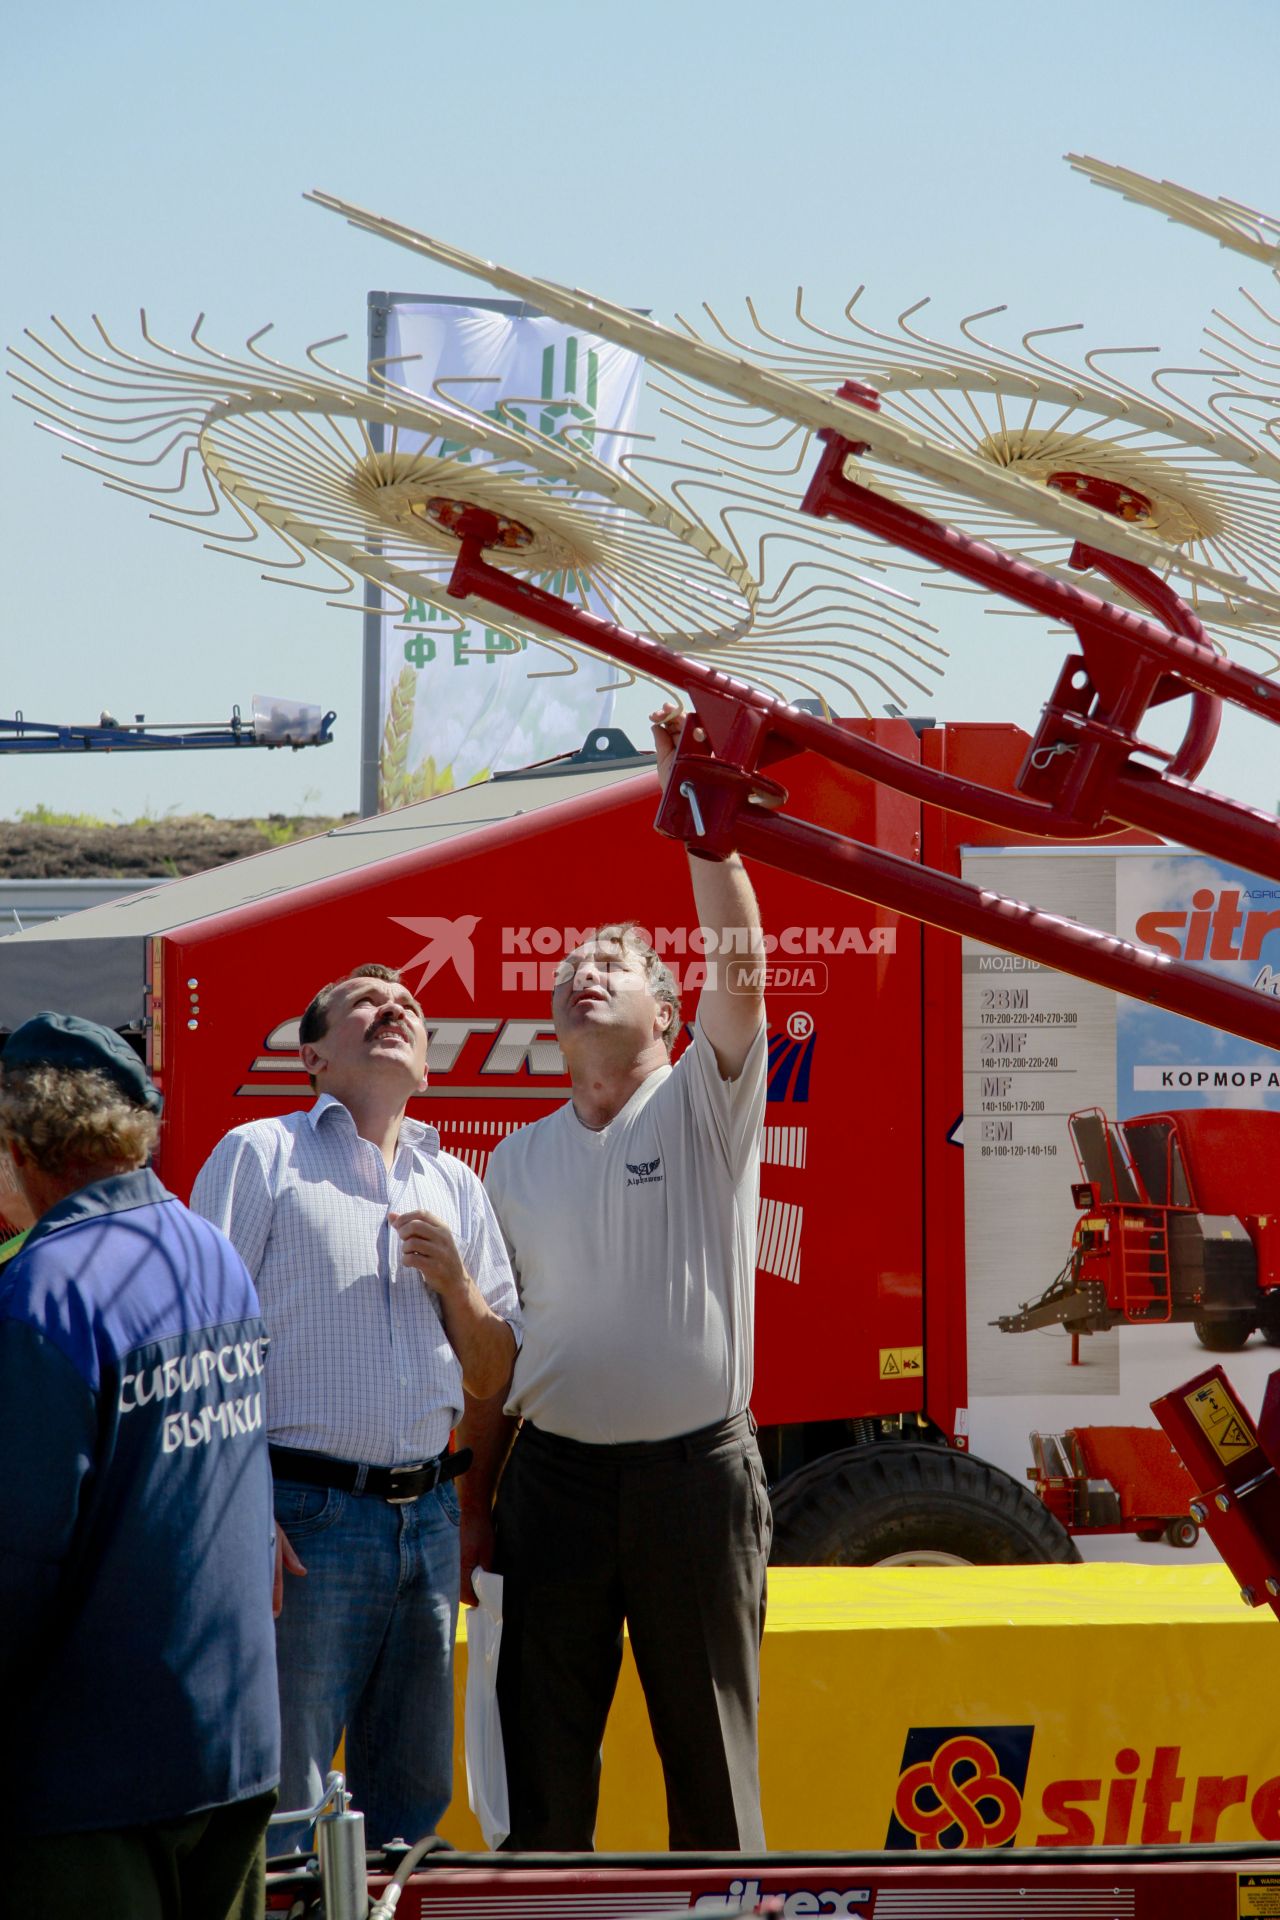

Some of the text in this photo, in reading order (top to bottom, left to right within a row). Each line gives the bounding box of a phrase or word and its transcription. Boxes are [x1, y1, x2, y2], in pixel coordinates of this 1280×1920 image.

[981, 1033, 1027, 1053] 2MF
[981, 1077, 1012, 1097] MF
[981, 1121, 1013, 1142] EM
[162, 1392, 262, 1453] БЫЧКИ
